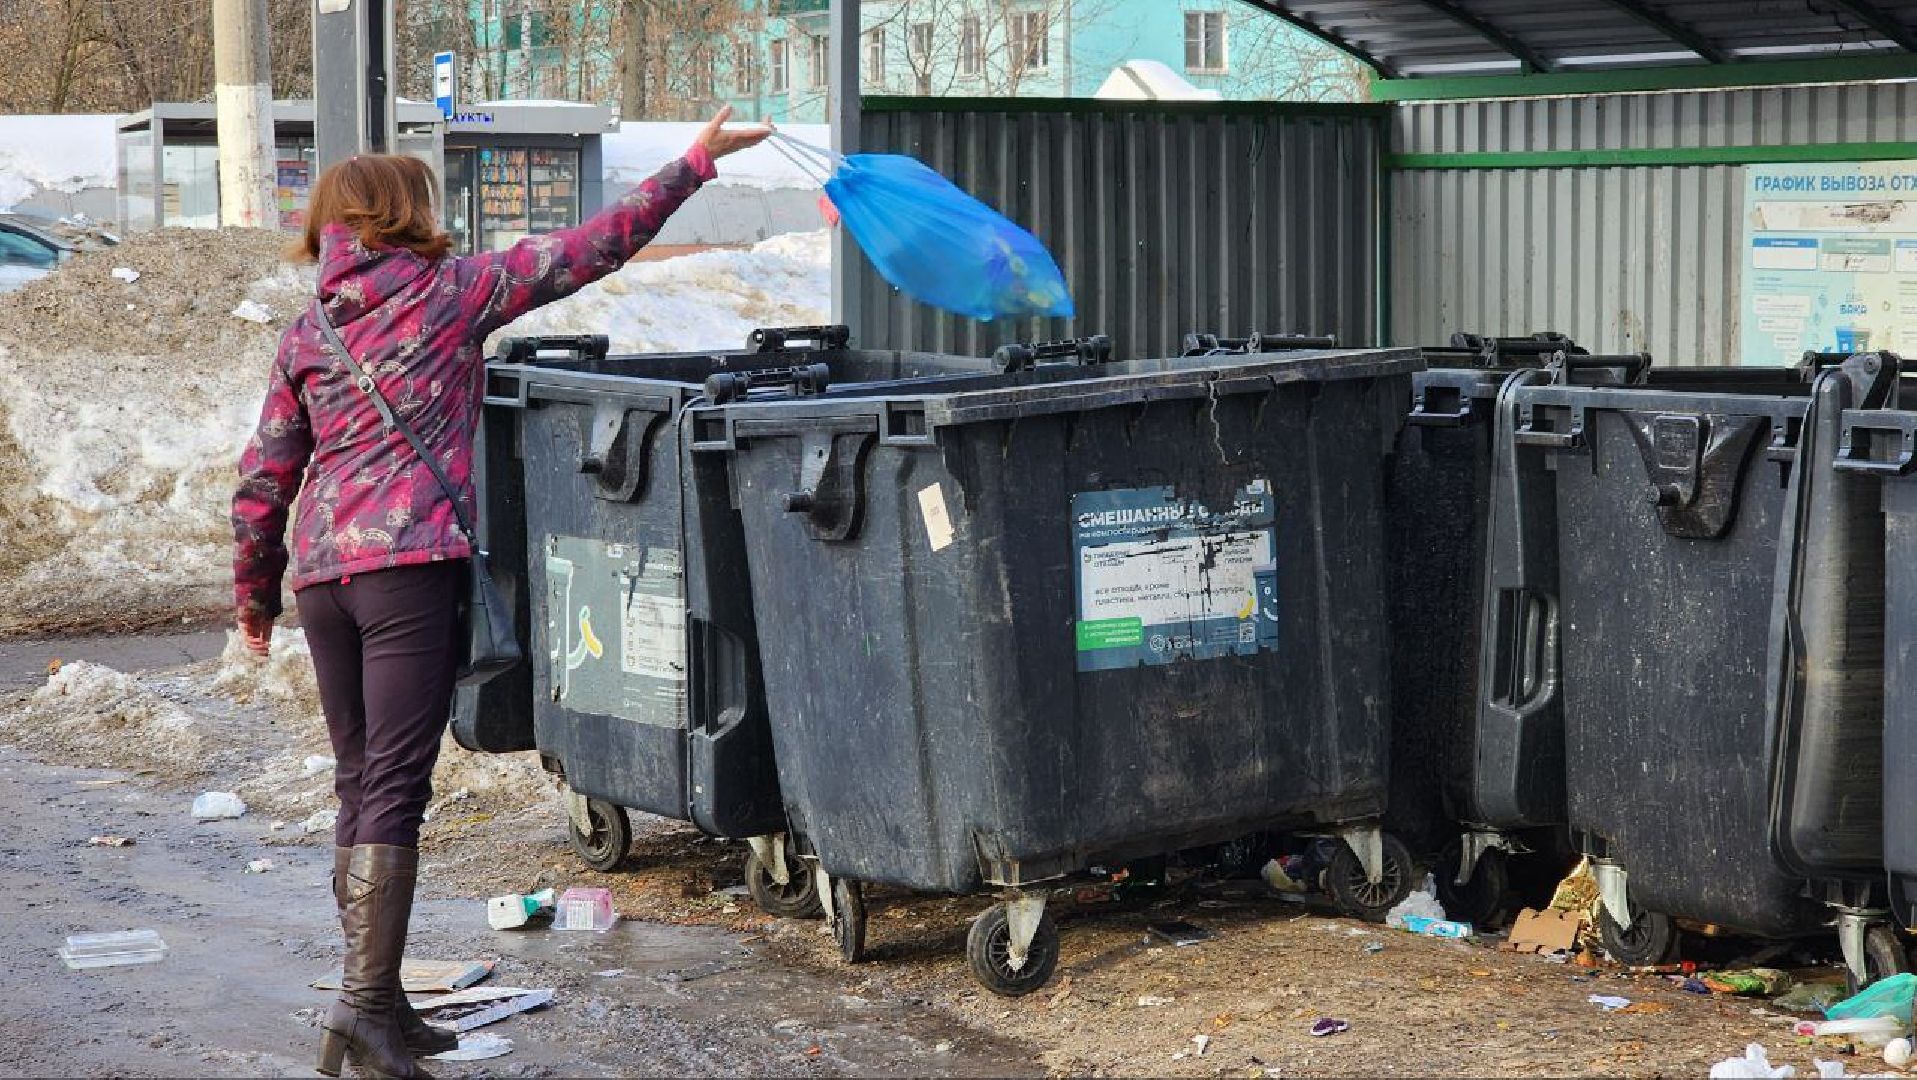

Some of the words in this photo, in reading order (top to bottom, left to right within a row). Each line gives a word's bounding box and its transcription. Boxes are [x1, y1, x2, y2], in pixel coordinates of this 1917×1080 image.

[451, 112, 494, 122] ДУКТЫ
[1755, 175, 1816, 191] ГРАФИК
[1821, 175, 1885, 191] ВЫВОЗА
